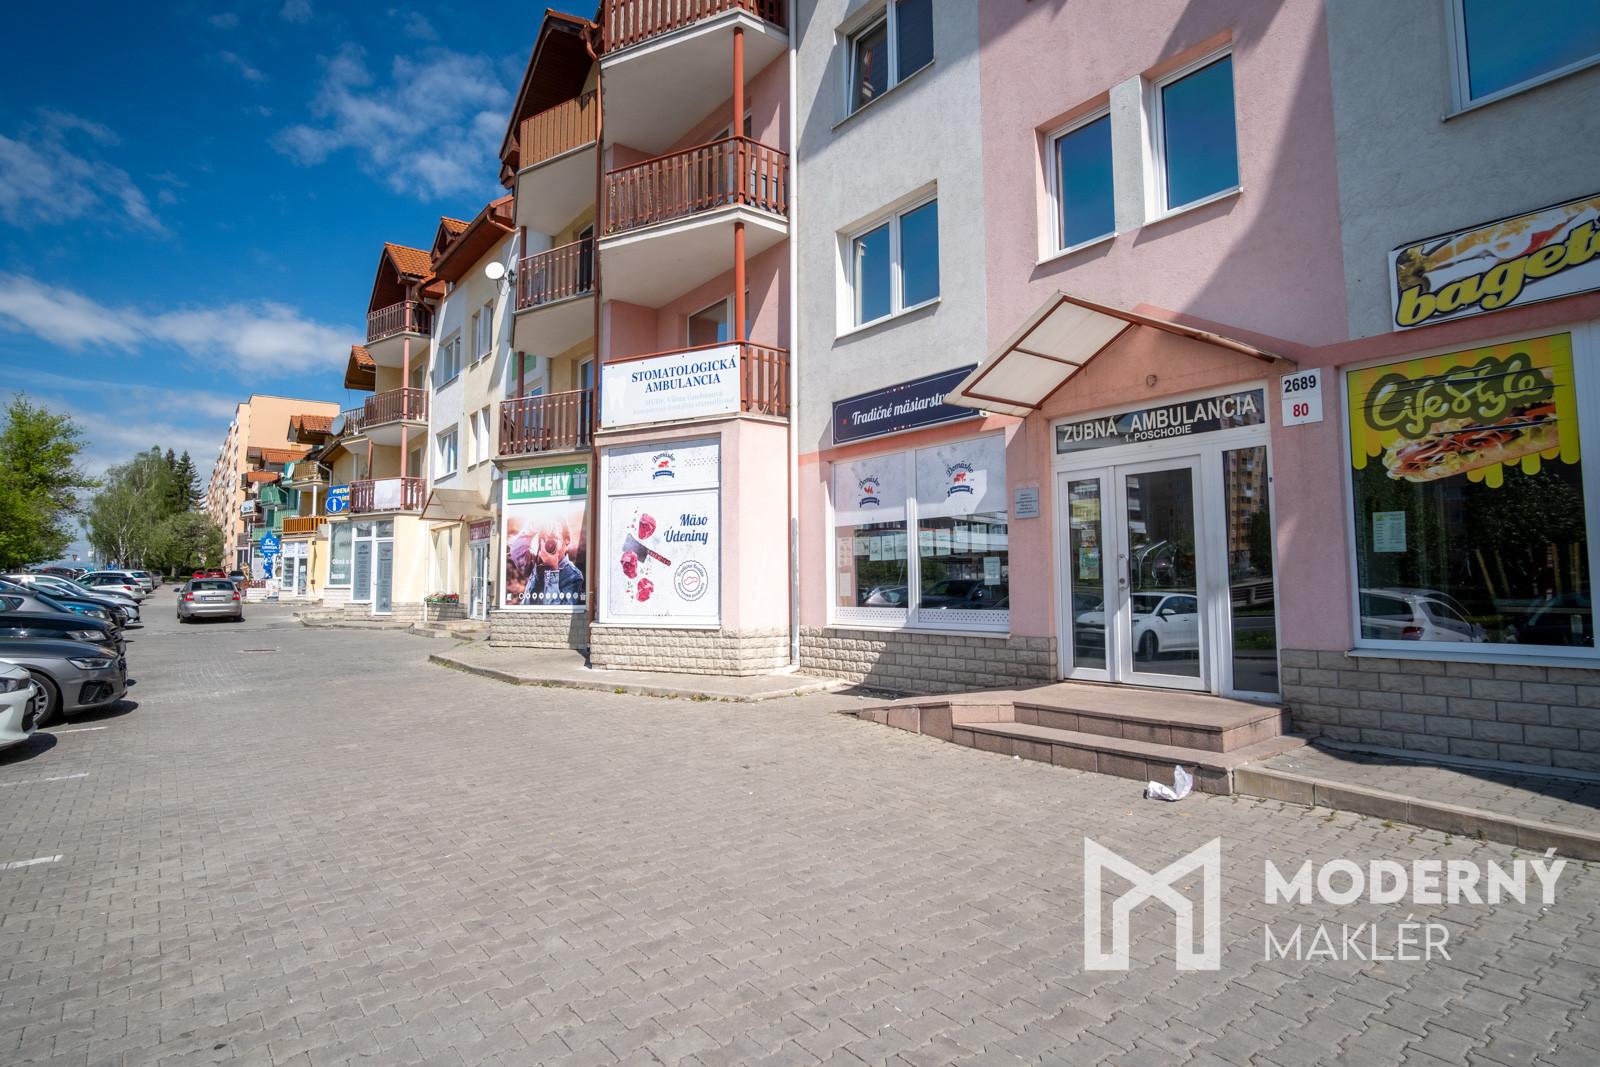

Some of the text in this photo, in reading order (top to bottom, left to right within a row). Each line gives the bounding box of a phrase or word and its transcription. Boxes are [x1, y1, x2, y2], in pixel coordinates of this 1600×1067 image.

[632, 357, 737, 382] STOMATOLOGICKÁ
[645, 373, 721, 394] AMBULANCIA
[1284, 375, 1317, 393] 2689
[852, 402, 892, 426] Tradičné
[1064, 394, 1256, 443] ZUBNÁ AMBULANCIA
[1292, 402, 1309, 418] 80
[1124, 424, 1192, 443] 1. POSCHODIE
[680, 513, 708, 527] Mäso
